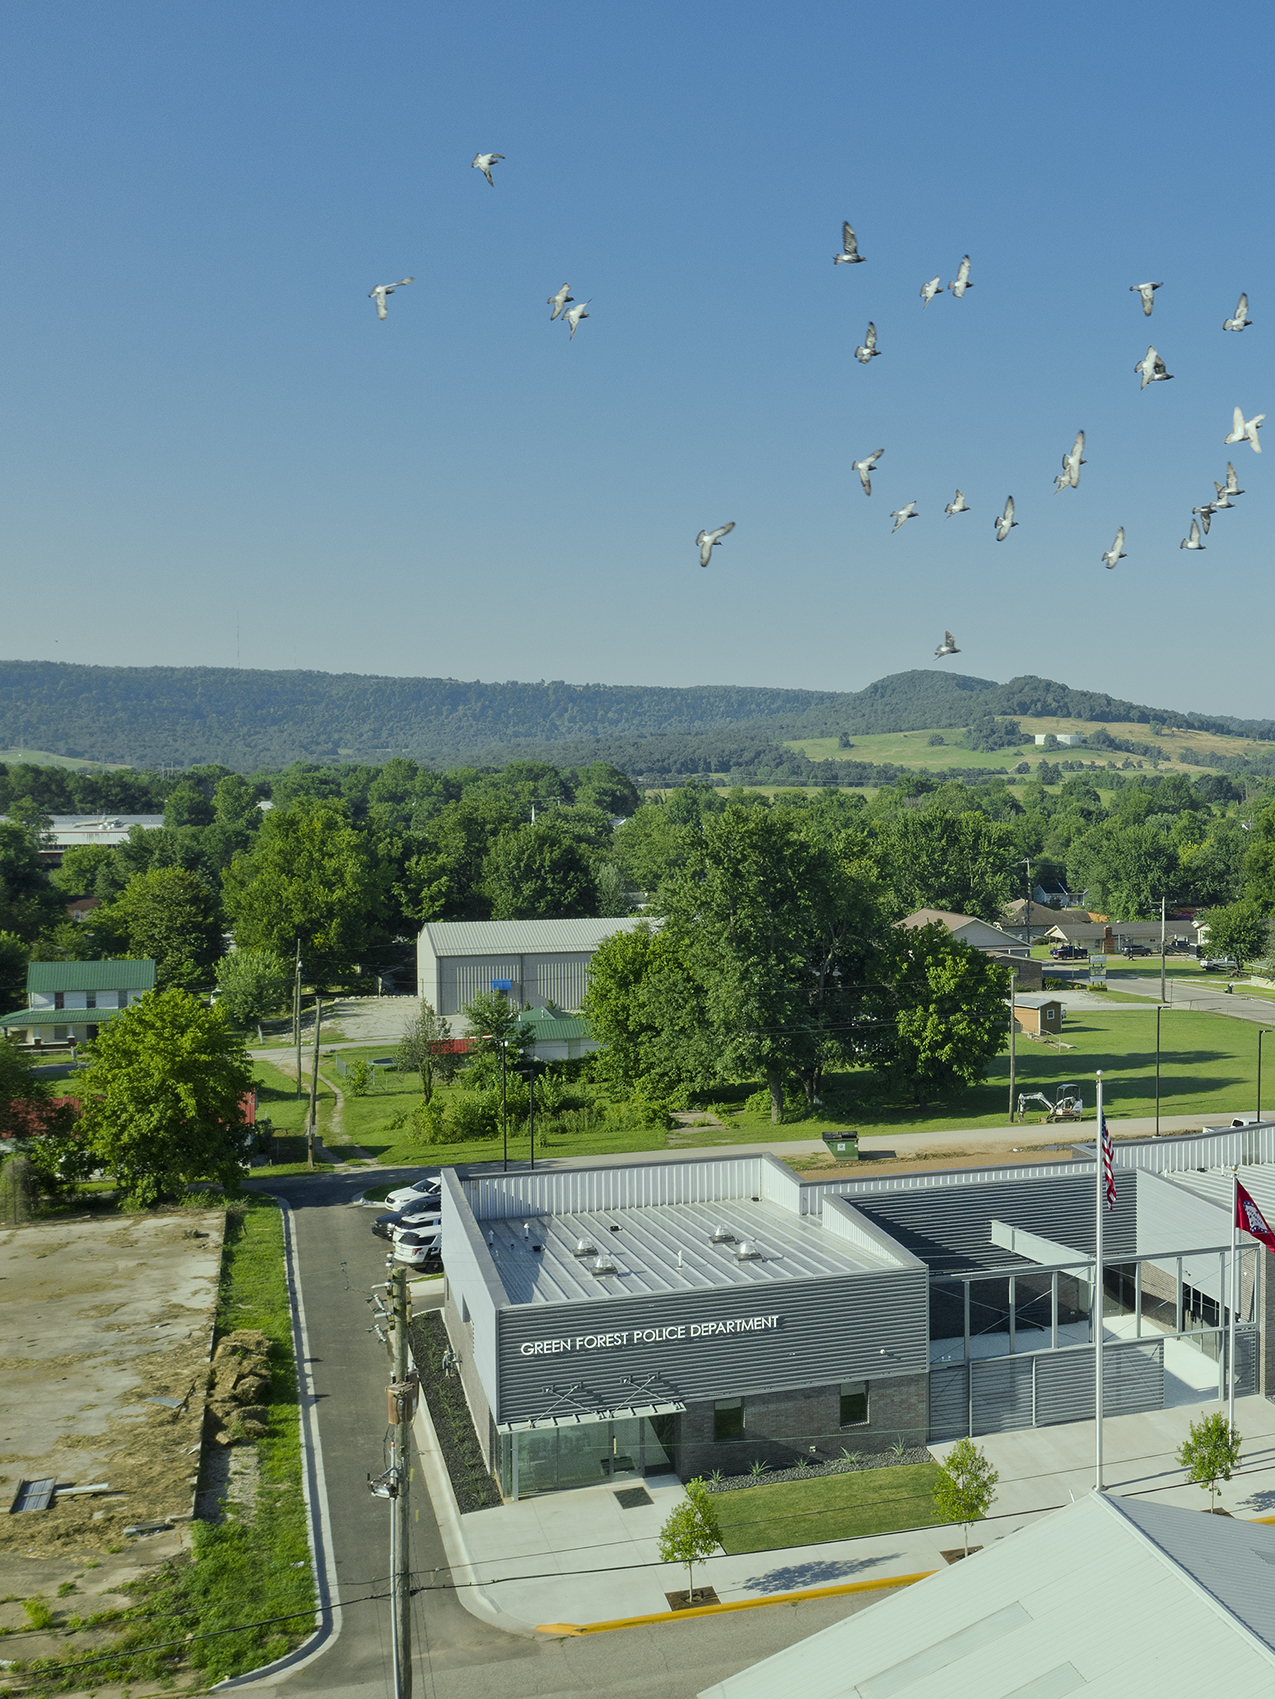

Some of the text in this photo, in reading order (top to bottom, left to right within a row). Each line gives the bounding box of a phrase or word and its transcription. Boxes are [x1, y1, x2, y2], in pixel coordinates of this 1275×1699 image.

[521, 1316, 779, 1356] GREEN FOREST POLICE DEPARTMENT
